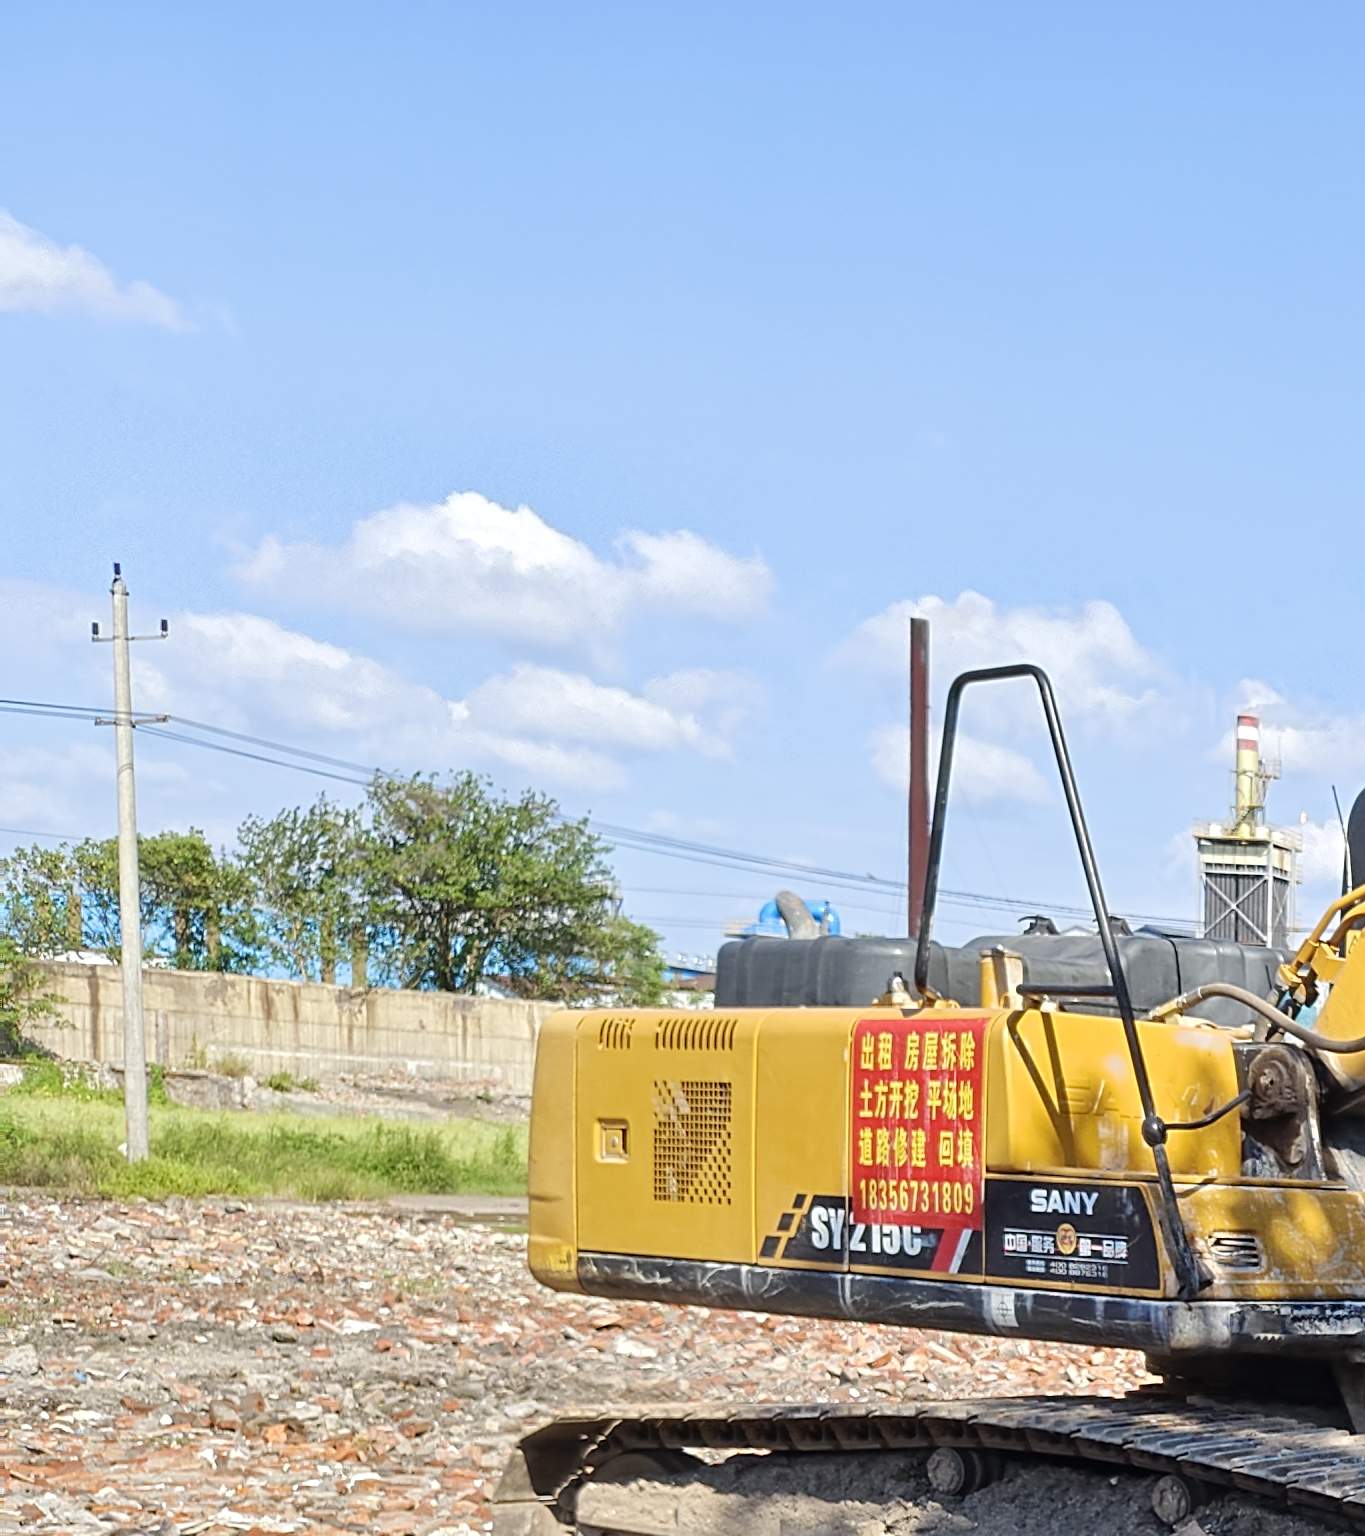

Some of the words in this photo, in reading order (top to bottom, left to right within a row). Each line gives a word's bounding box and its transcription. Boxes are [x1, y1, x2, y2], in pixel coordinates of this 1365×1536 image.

[860, 1031, 893, 1071] 出租
[904, 1030, 976, 1072] 房屋拆除
[859, 1079, 919, 1120] 土方开挖
[927, 1080, 974, 1121] 平场地
[859, 1126, 926, 1168] 道路修建
[939, 1128, 974, 1169] 回填
[860, 1178, 974, 1215] 18356731809
[1031, 1188, 1099, 1215] SANY
